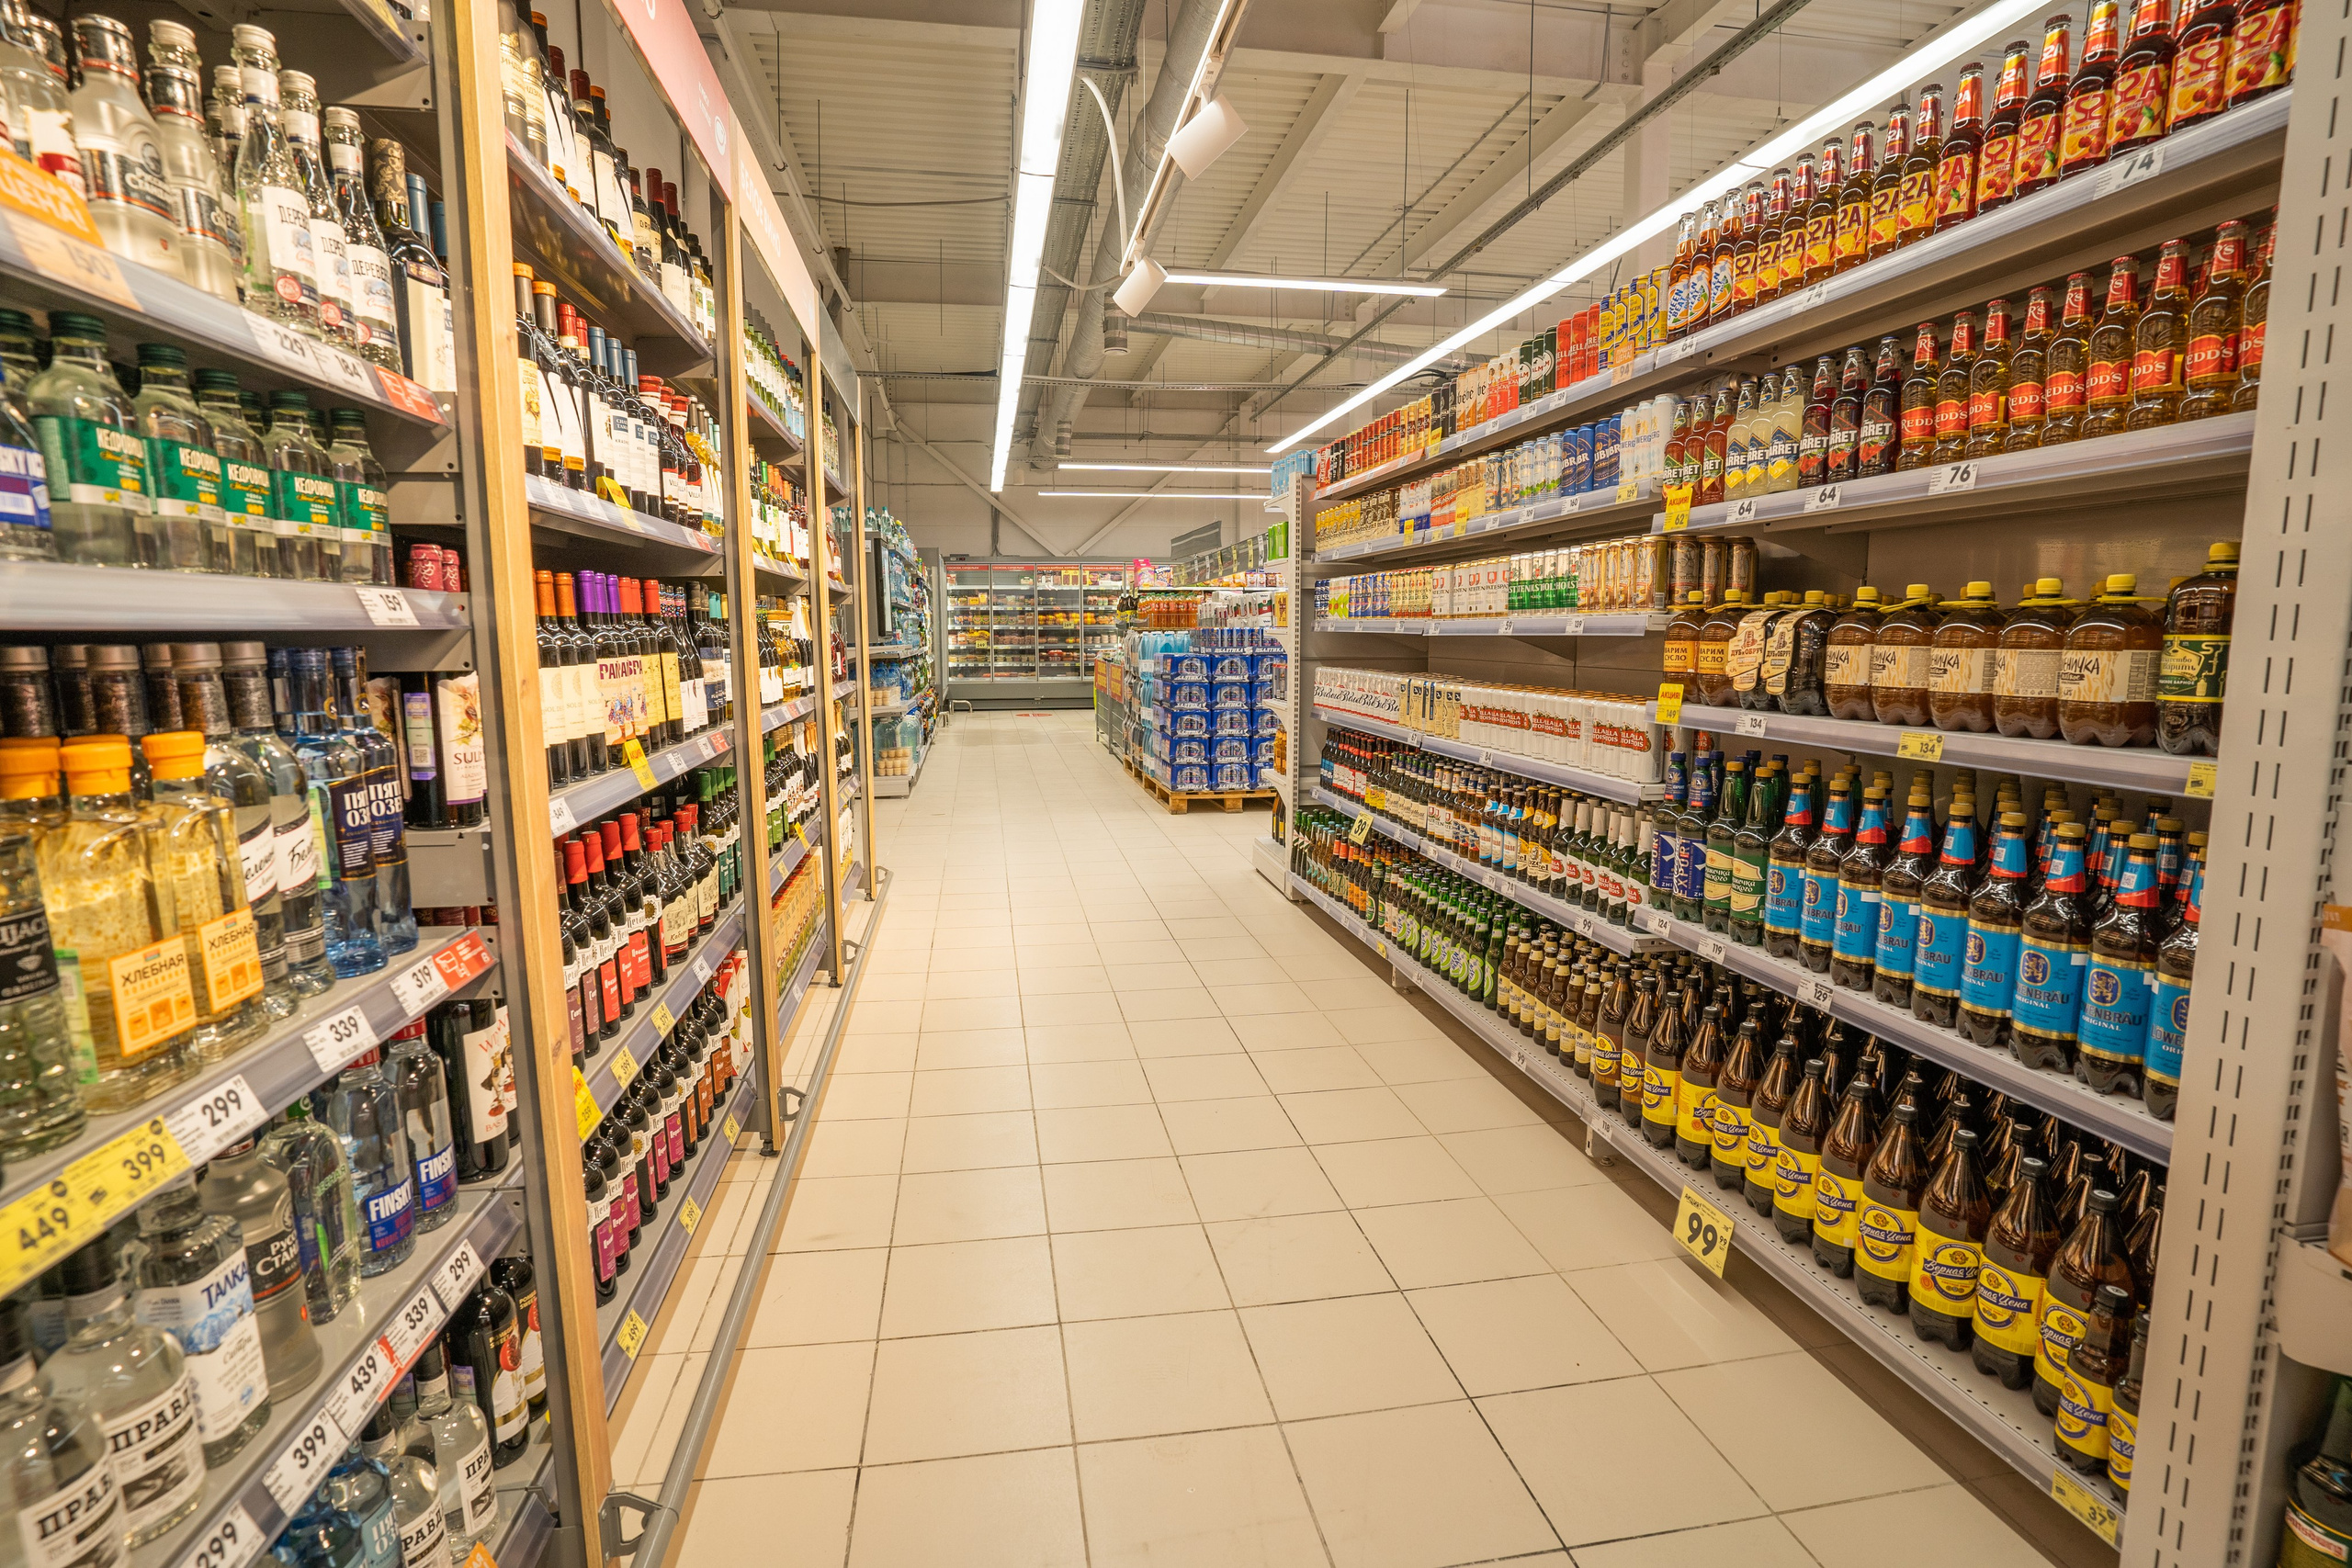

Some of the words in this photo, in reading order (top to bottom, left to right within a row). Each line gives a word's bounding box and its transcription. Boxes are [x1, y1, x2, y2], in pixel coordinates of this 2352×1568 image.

[2123, 152, 2154, 179] 74
[273, 329, 306, 358] 229
[334, 354, 364, 381] 184
[1950, 463, 1972, 485] 76
[1668, 493, 1690, 506] АКЦИЯ!
[1818, 487, 1837, 503] 64
[1737, 502, 1752, 515] 64
[1675, 513, 1685, 525] 62
[379, 593, 403, 613] 159
[1505, 621, 1512, 631] 59
[1664, 654, 1688, 662] СУСЛО
[1700, 655, 1724, 663] СУСЛО
[1660, 690, 1680, 700] АКЦИЯ!
[1667, 709, 1677, 718] 149
[1749, 716, 1763, 729] 134
[1919, 742, 1936, 754] 134
[1355, 818, 1366, 835] 39
[1507, 881, 1514, 892] 74
[1583, 920, 1592, 931] 99
[1657, 919, 1668, 930] 124
[209, 921, 256, 952] ХЛЕБНАЯ
[1712, 942, 1723, 954] 119
[120, 953, 186, 988] ХЛЕБНАЯ
[412, 964, 432, 989] 319
[1813, 987, 1828, 1001] 129
[329, 1014, 360, 1043] 339
[2082, 1015, 2123, 1032] ORIGINAL
[1517, 1054, 1525, 1065] 99
[201, 1088, 243, 1128] 299
[1729, 1123, 1748, 1135] Цена
[1757, 1145, 1777, 1156] Цена
[122, 1143, 165, 1181] 399
[1787, 1168, 1809, 1182] Цена
[1830, 1195, 1854, 1211] Цена
[18, 1206, 70, 1251] 449
[1886, 1230, 1913, 1243] Цена
[449, 1250, 471, 1282] 299
[1925, 1258, 1964, 1280] Верная
[405, 1296, 429, 1331] 339
[628, 1323, 640, 1343] 499
[351, 1354, 379, 1395] 439
[293, 1425, 327, 1471] 399
[197, 1521, 238, 1568] 299
